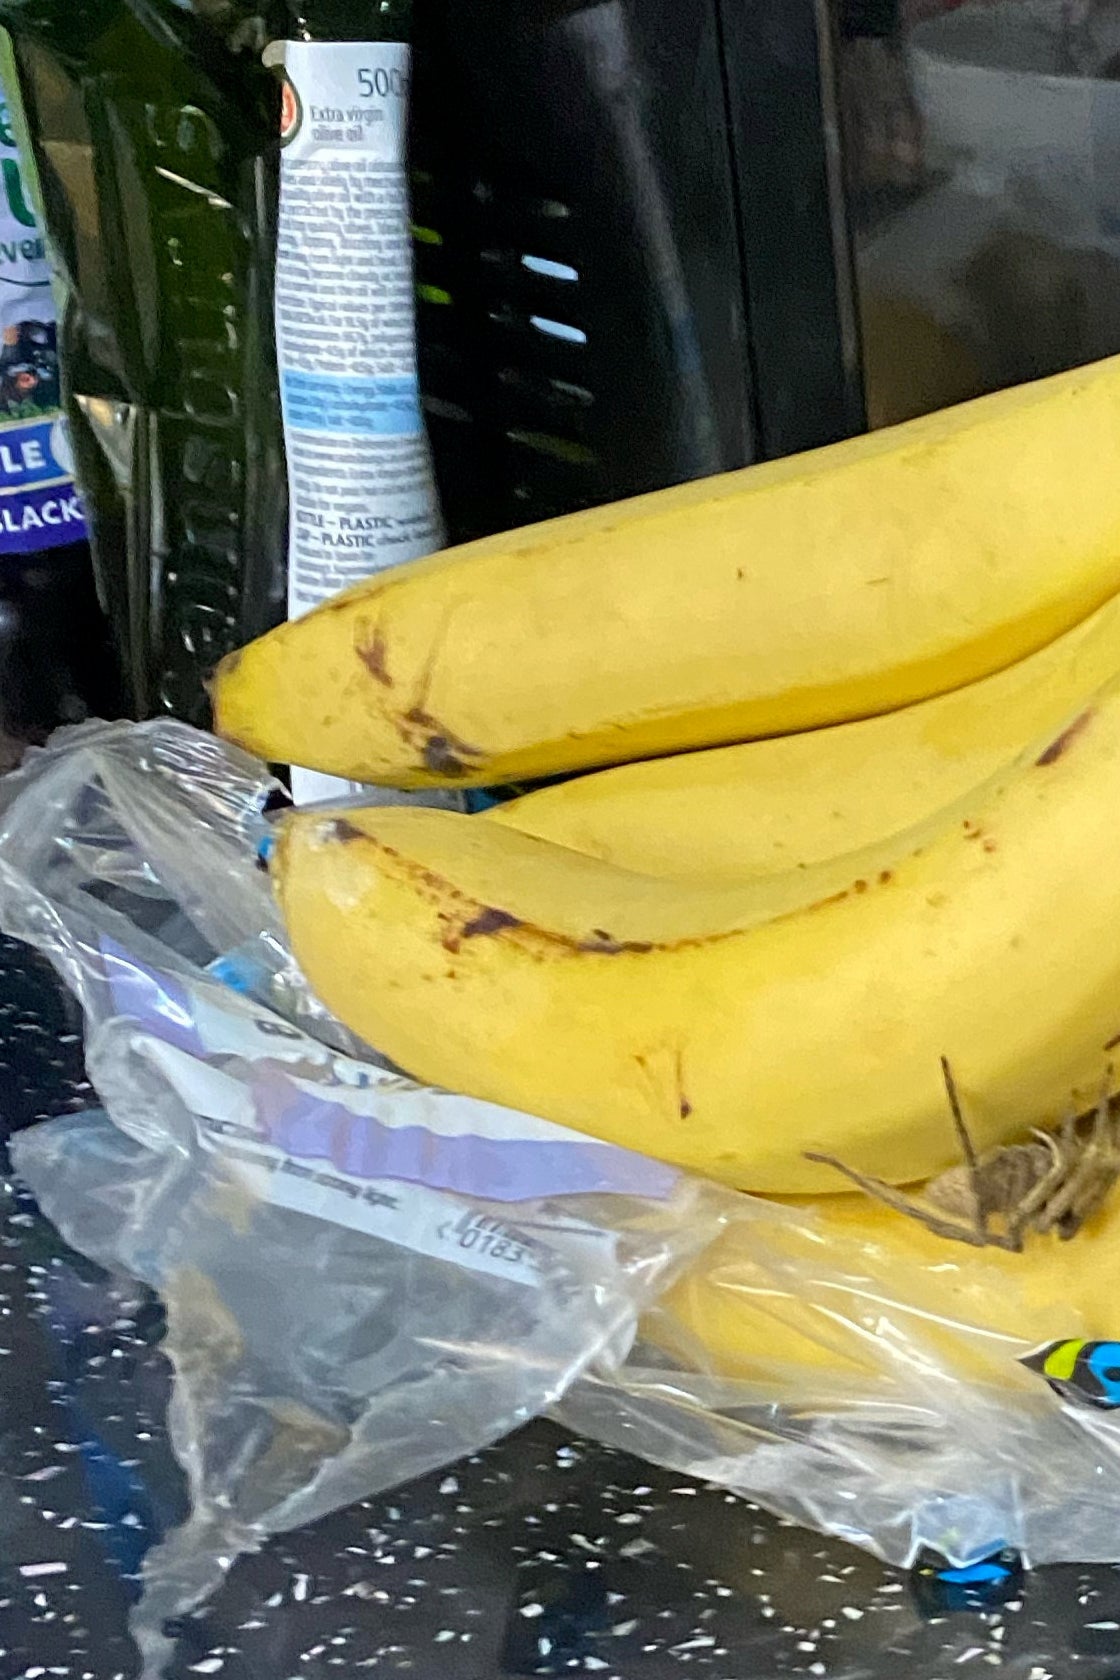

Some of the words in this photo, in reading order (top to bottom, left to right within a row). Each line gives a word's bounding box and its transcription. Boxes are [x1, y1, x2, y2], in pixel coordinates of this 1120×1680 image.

[310, 105, 344, 121] Extra
[0, 496, 85, 534] LACK
[339, 516, 393, 530] PLASTIC
[321, 532, 375, 547] PLASTIC
